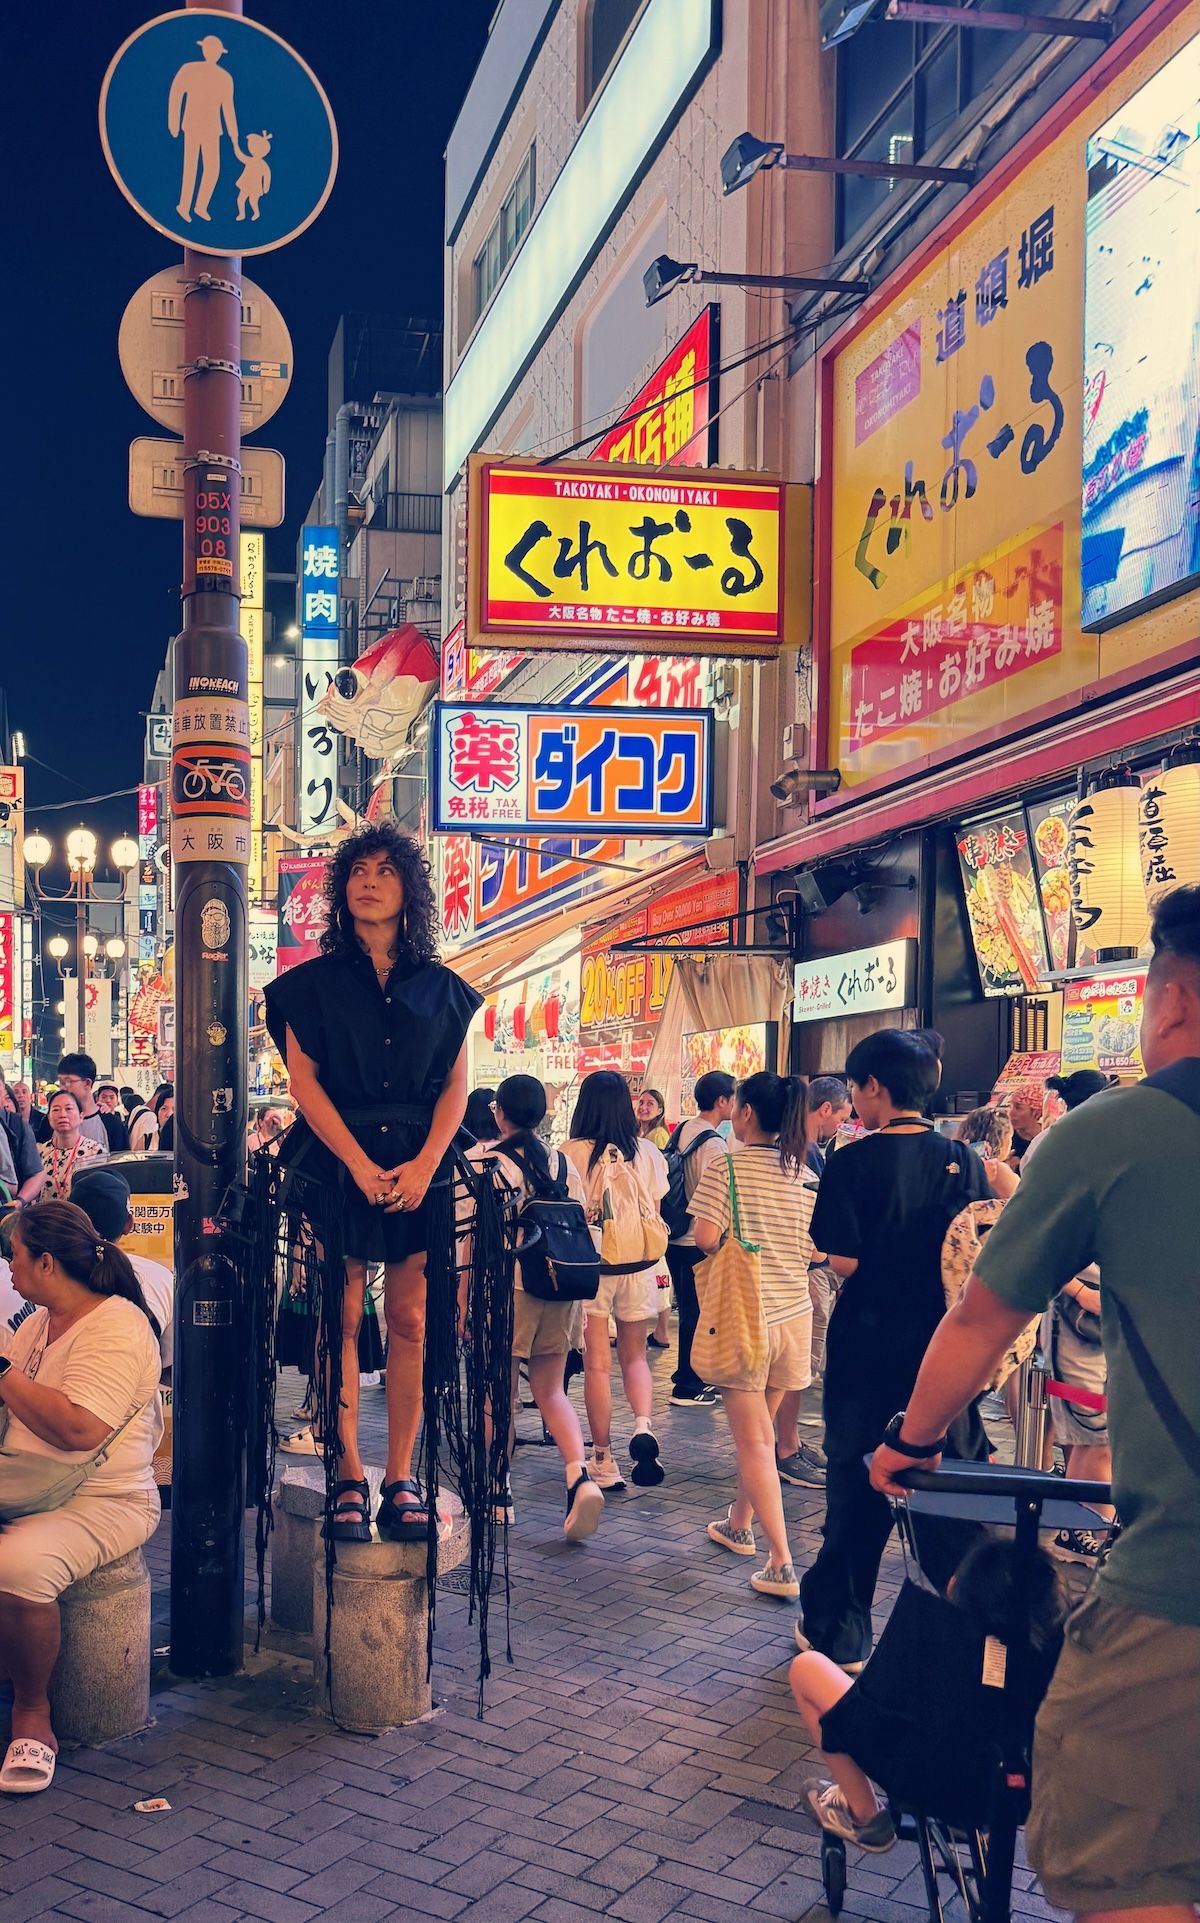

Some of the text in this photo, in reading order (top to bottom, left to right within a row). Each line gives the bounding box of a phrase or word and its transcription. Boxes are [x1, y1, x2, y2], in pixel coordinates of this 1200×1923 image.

[935, 204, 1054, 366] 道頓堀
[870, 348, 904, 384] TAKOYAKI
[864, 381, 912, 431] OKONOMIYAKI
[855, 341, 1064, 590] くれおーる
[196, 492, 231, 512] 05X
[196, 516, 231, 535] 903
[201, 539, 226, 557] 08
[504, 509, 763, 598] くれおーる
[304, 544, 339, 623] 焼肉
[548, 605, 602, 622] 大阪名物
[899, 577, 995, 665] 大阪名物
[305, 671, 334, 825] いろり
[448, 711, 520, 792] 薬
[534, 725, 697, 813] ダイコク
[447, 796, 489, 819] 免税
[492, 809, 521, 819] FREE
[496, 798, 518, 808] TAX
[182, 833, 246, 852] 大阪市
[963, 825, 1021, 868] 串焼き
[662, 909, 675, 924] Over
[692, 899, 703, 913] Yen
[799, 974, 831, 1001] 串焼き
[837, 956, 897, 1005] くれおーる
